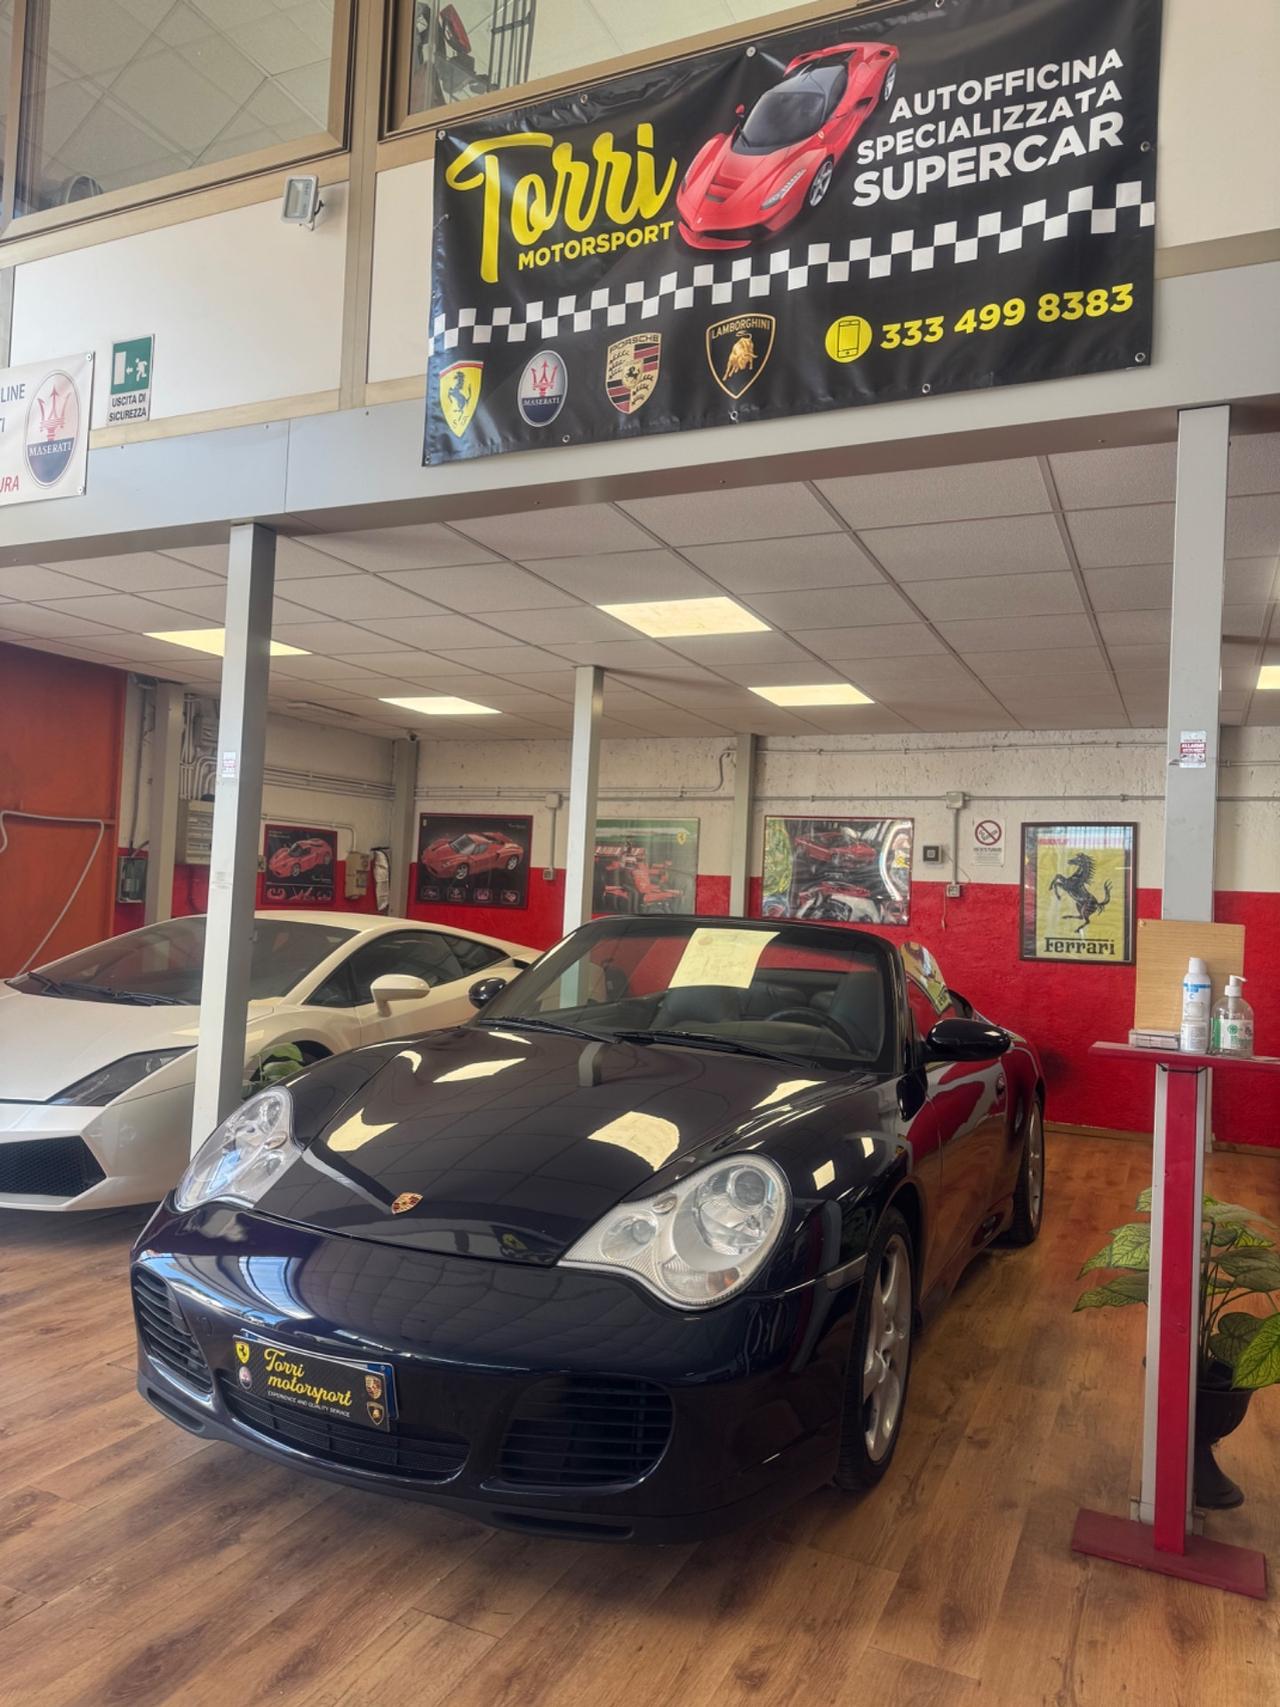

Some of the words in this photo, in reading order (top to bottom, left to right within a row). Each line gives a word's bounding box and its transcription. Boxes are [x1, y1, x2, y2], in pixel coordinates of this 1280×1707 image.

[889, 48, 1124, 123] AUTOFFICINA
[856, 80, 1123, 165] SPECIALIZZATA
[852, 111, 1124, 207] SUPERCAR
[446, 123, 678, 283] Torri
[517, 221, 674, 271] MOTORSPORT
[711, 317, 771, 340] LAMBORGHINI
[880, 316, 945, 350] 333
[953, 297, 1027, 335] 499
[1036, 283, 1135, 323] 8383
[609, 334, 660, 353] PORSCHE
[109, 408, 147, 422] SICUREZZA
[112, 395, 137, 408] USCITA
[138, 393, 147, 403] DI
[523, 397, 560, 406] MASERATI
[29, 441, 72, 456] MASERATI
[1044, 937, 1116, 955] Ferrari
[263, 1347, 305, 1377] Torri
[267, 1374, 353, 1407] motorsport
